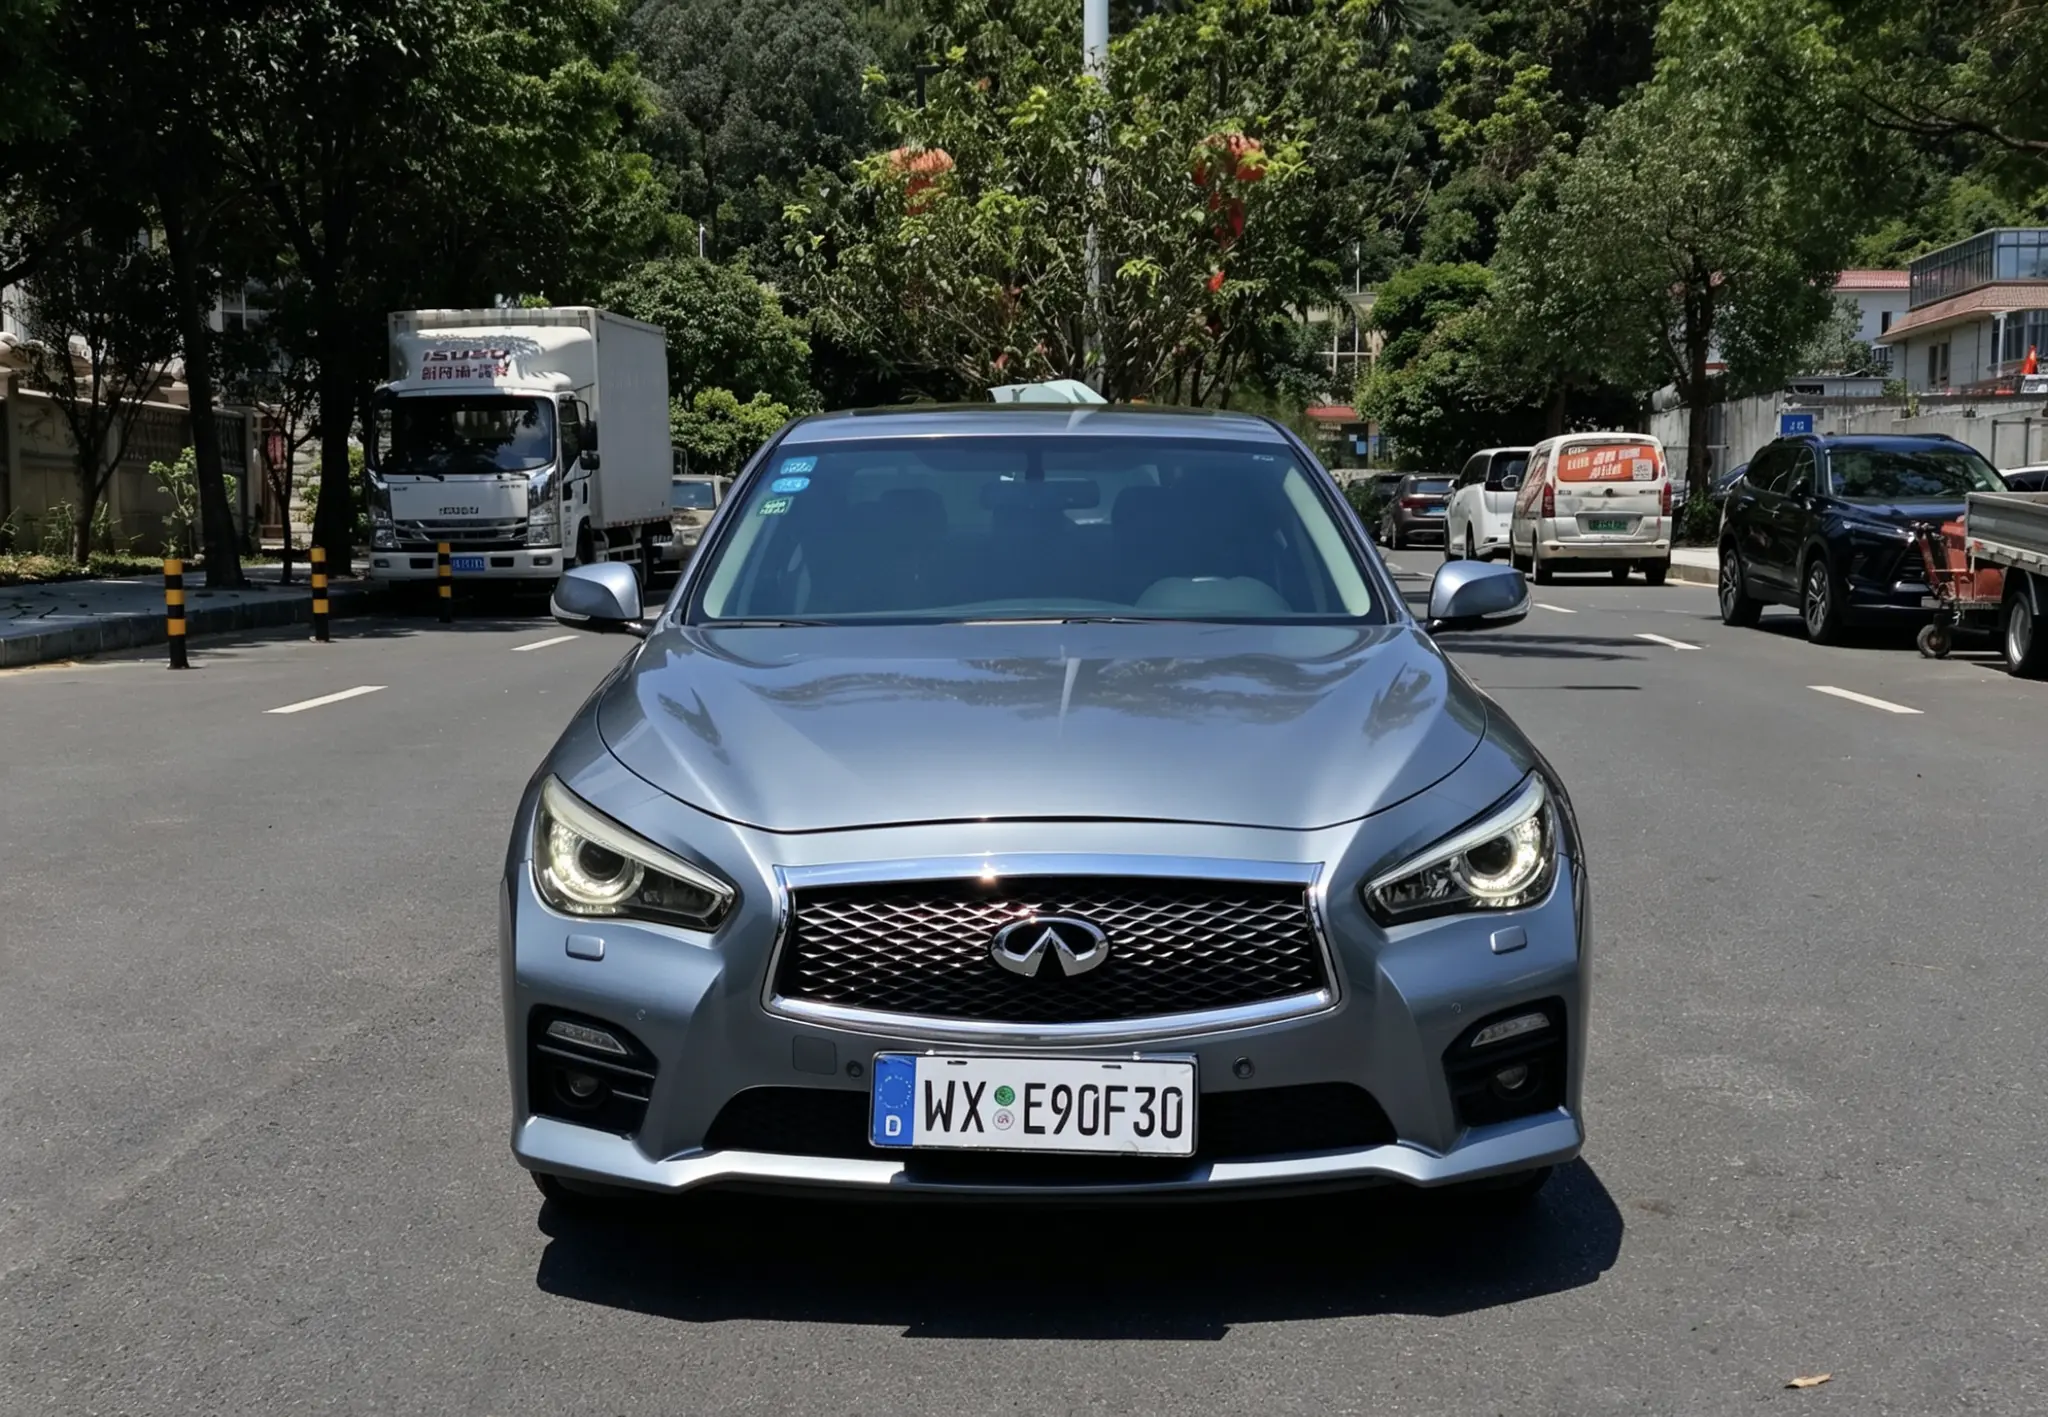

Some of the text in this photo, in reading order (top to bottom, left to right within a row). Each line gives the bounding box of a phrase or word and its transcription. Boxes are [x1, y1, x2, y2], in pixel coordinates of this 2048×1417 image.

[885, 1115, 902, 1136] D
[925, 1080, 1183, 1138] WX E90F30
